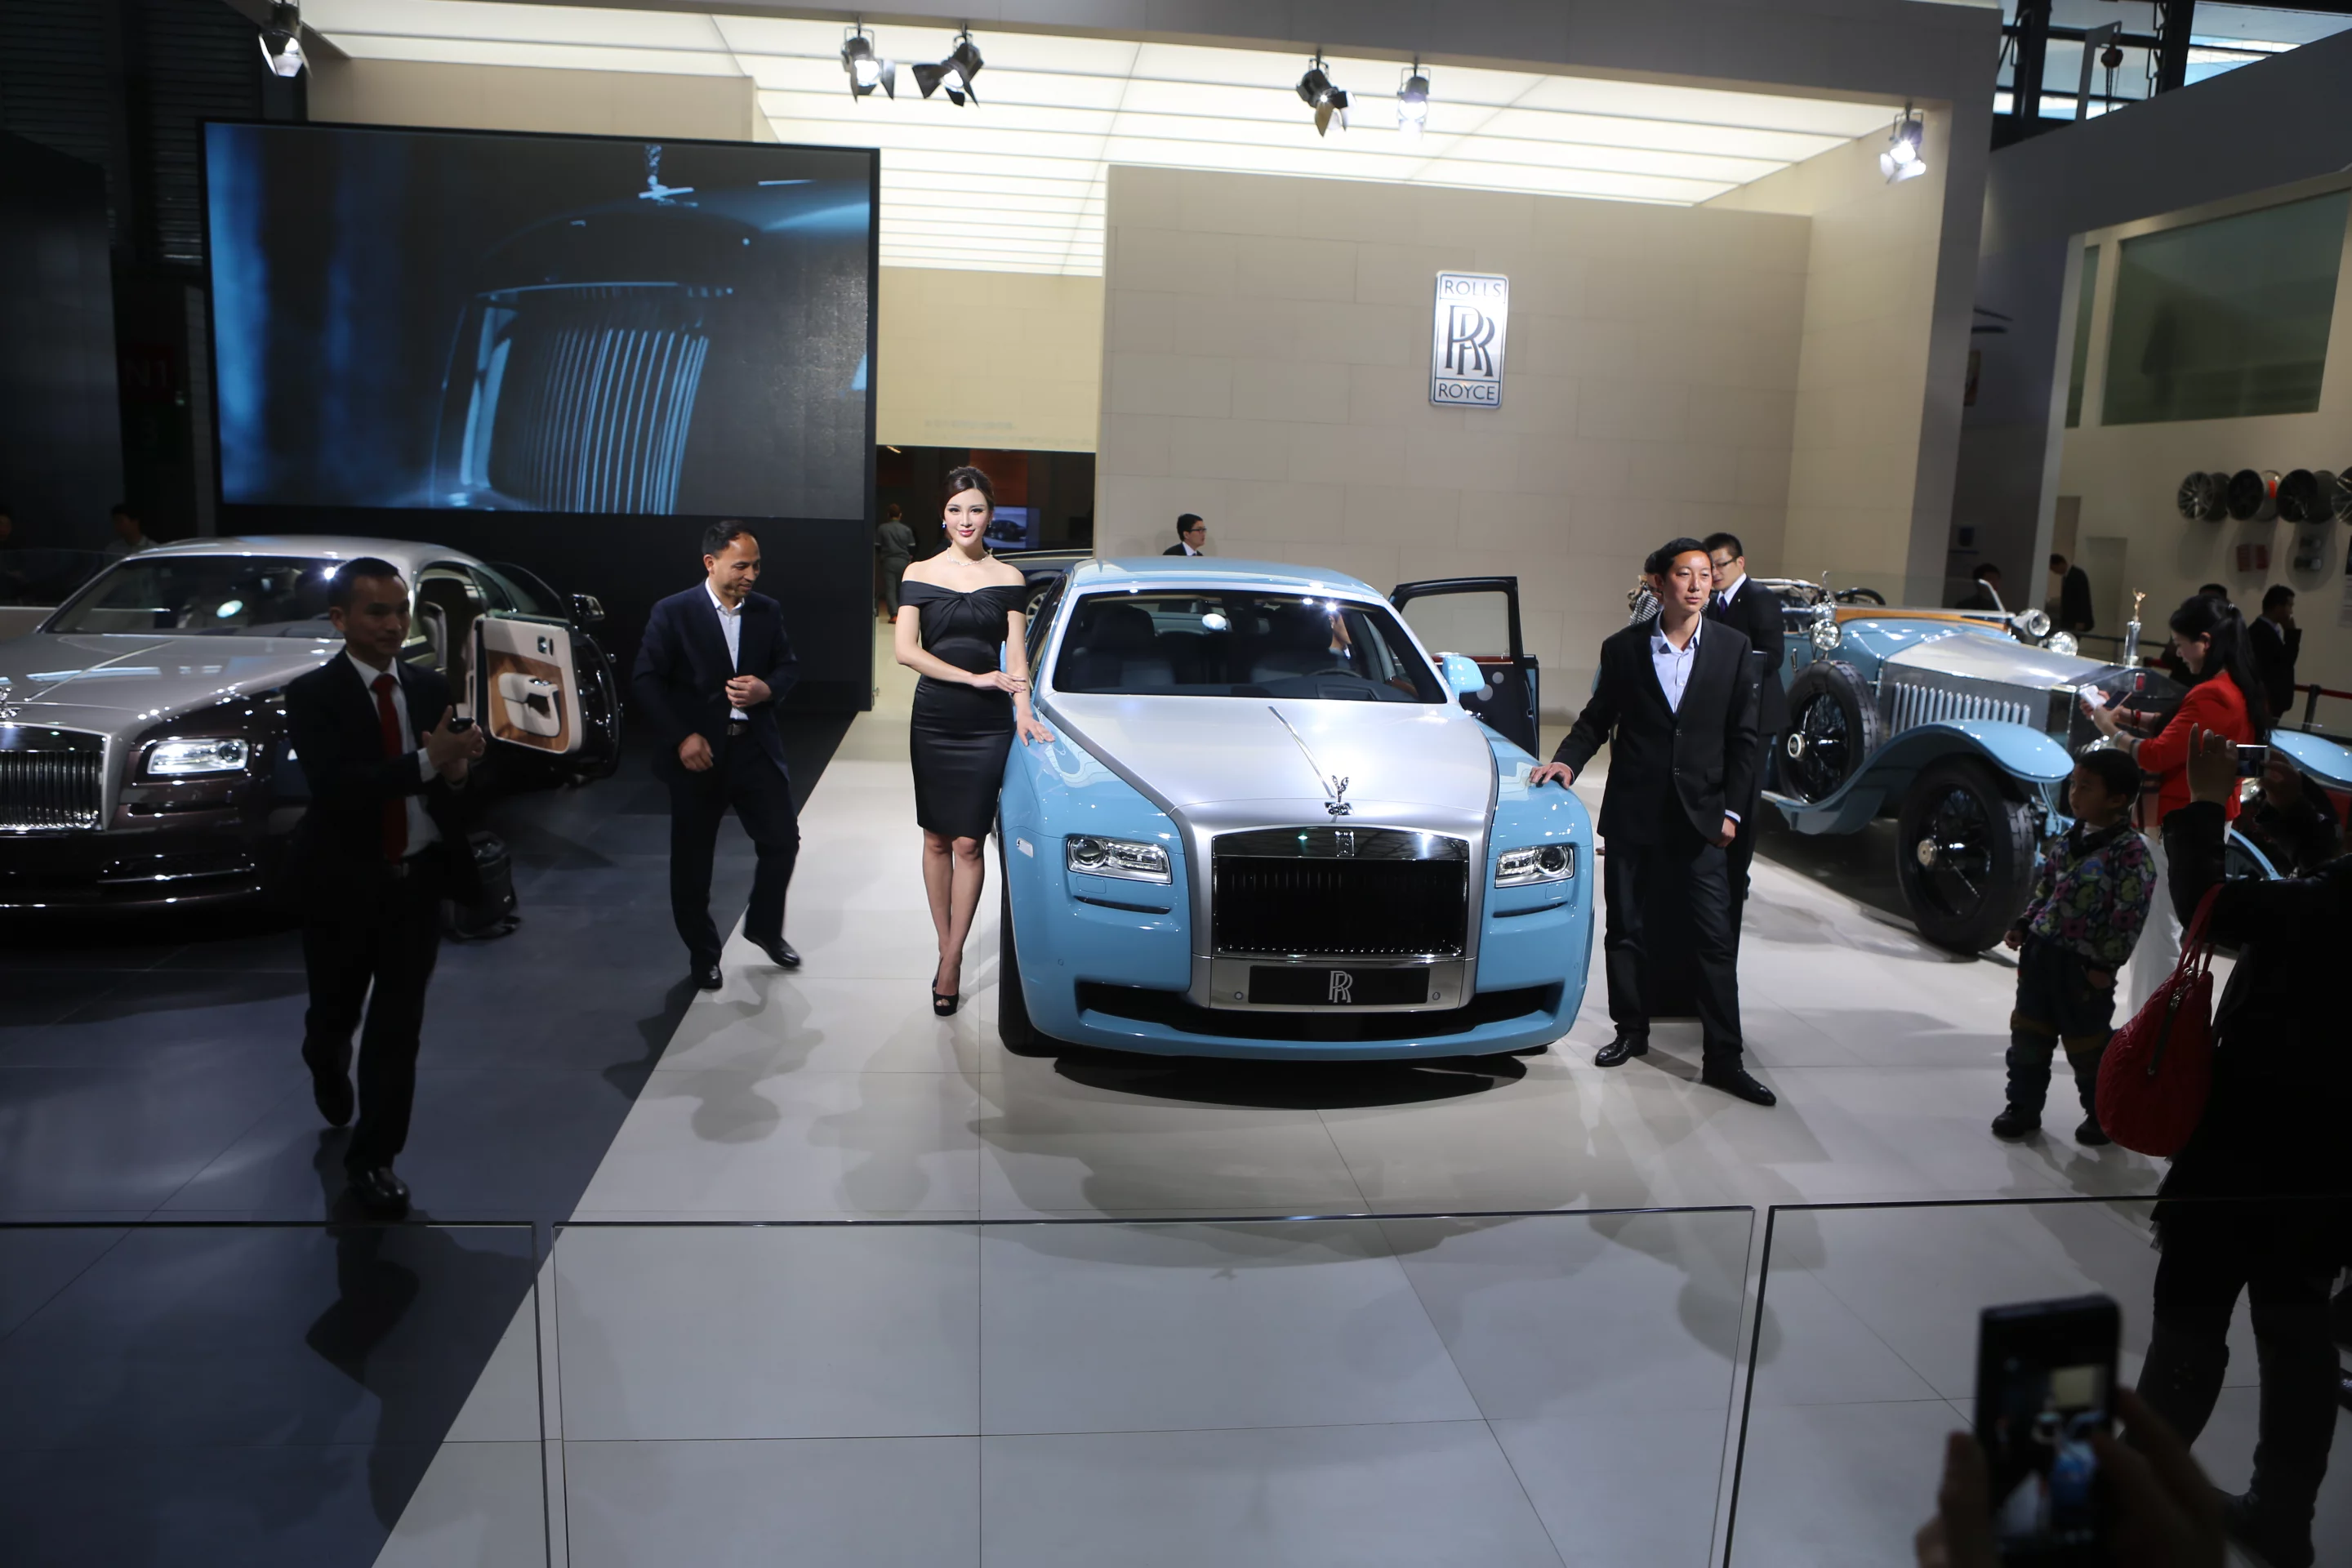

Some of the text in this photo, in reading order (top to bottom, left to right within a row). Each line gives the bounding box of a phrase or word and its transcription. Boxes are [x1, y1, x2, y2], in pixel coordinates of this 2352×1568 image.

[1445, 280, 1502, 297] ROLLS
[124, 359, 167, 388] N1
[1438, 383, 1495, 401] ROYCE
[1328, 970, 1353, 1004] RR
